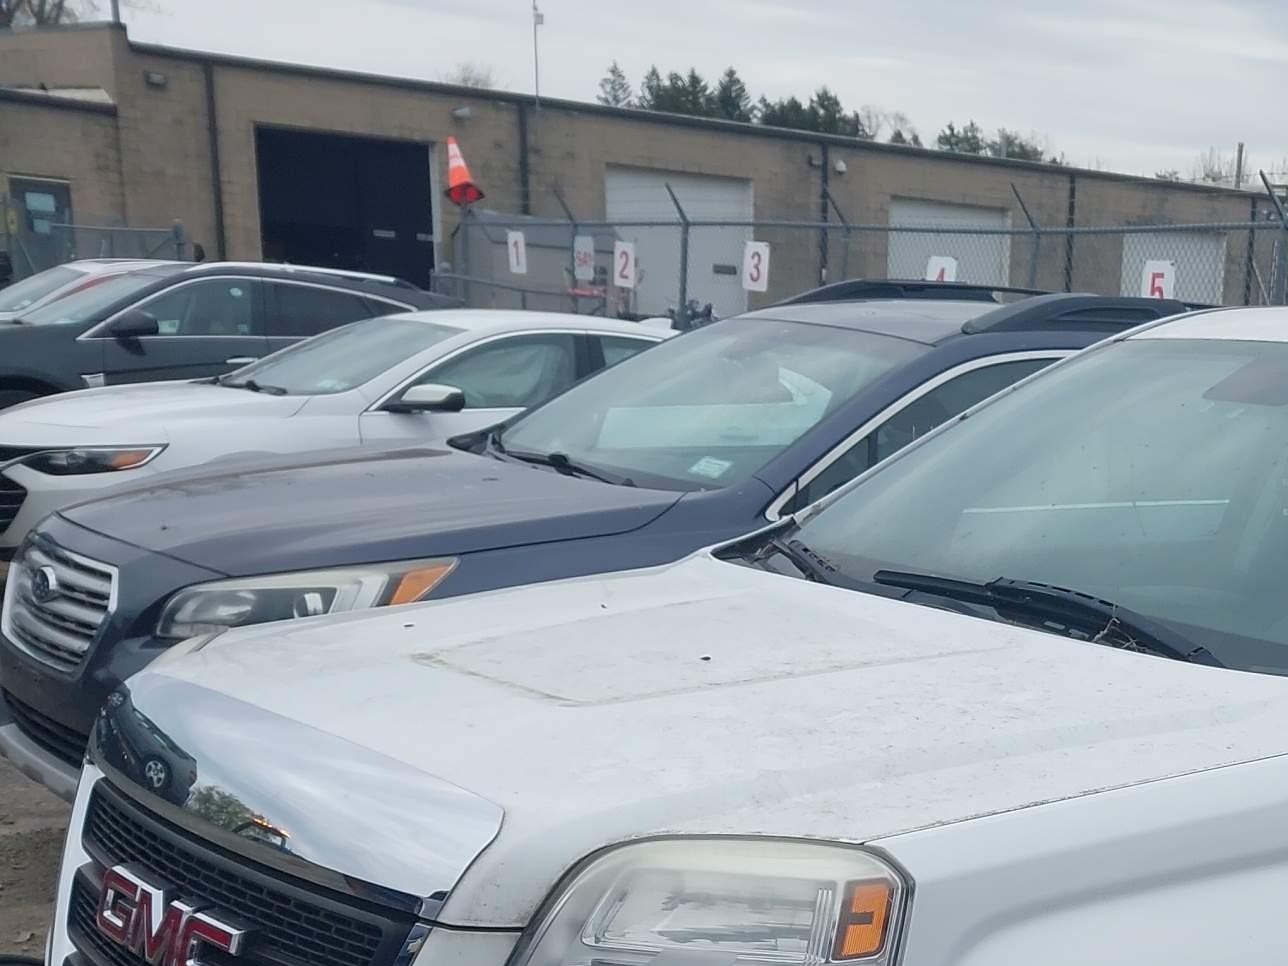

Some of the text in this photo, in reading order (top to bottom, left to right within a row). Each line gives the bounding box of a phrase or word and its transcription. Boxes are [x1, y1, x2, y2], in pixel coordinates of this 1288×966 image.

[512, 239, 521, 267] 1
[618, 250, 630, 280] 2
[749, 250, 762, 282] 3
[1150, 272, 1165, 299] 5
